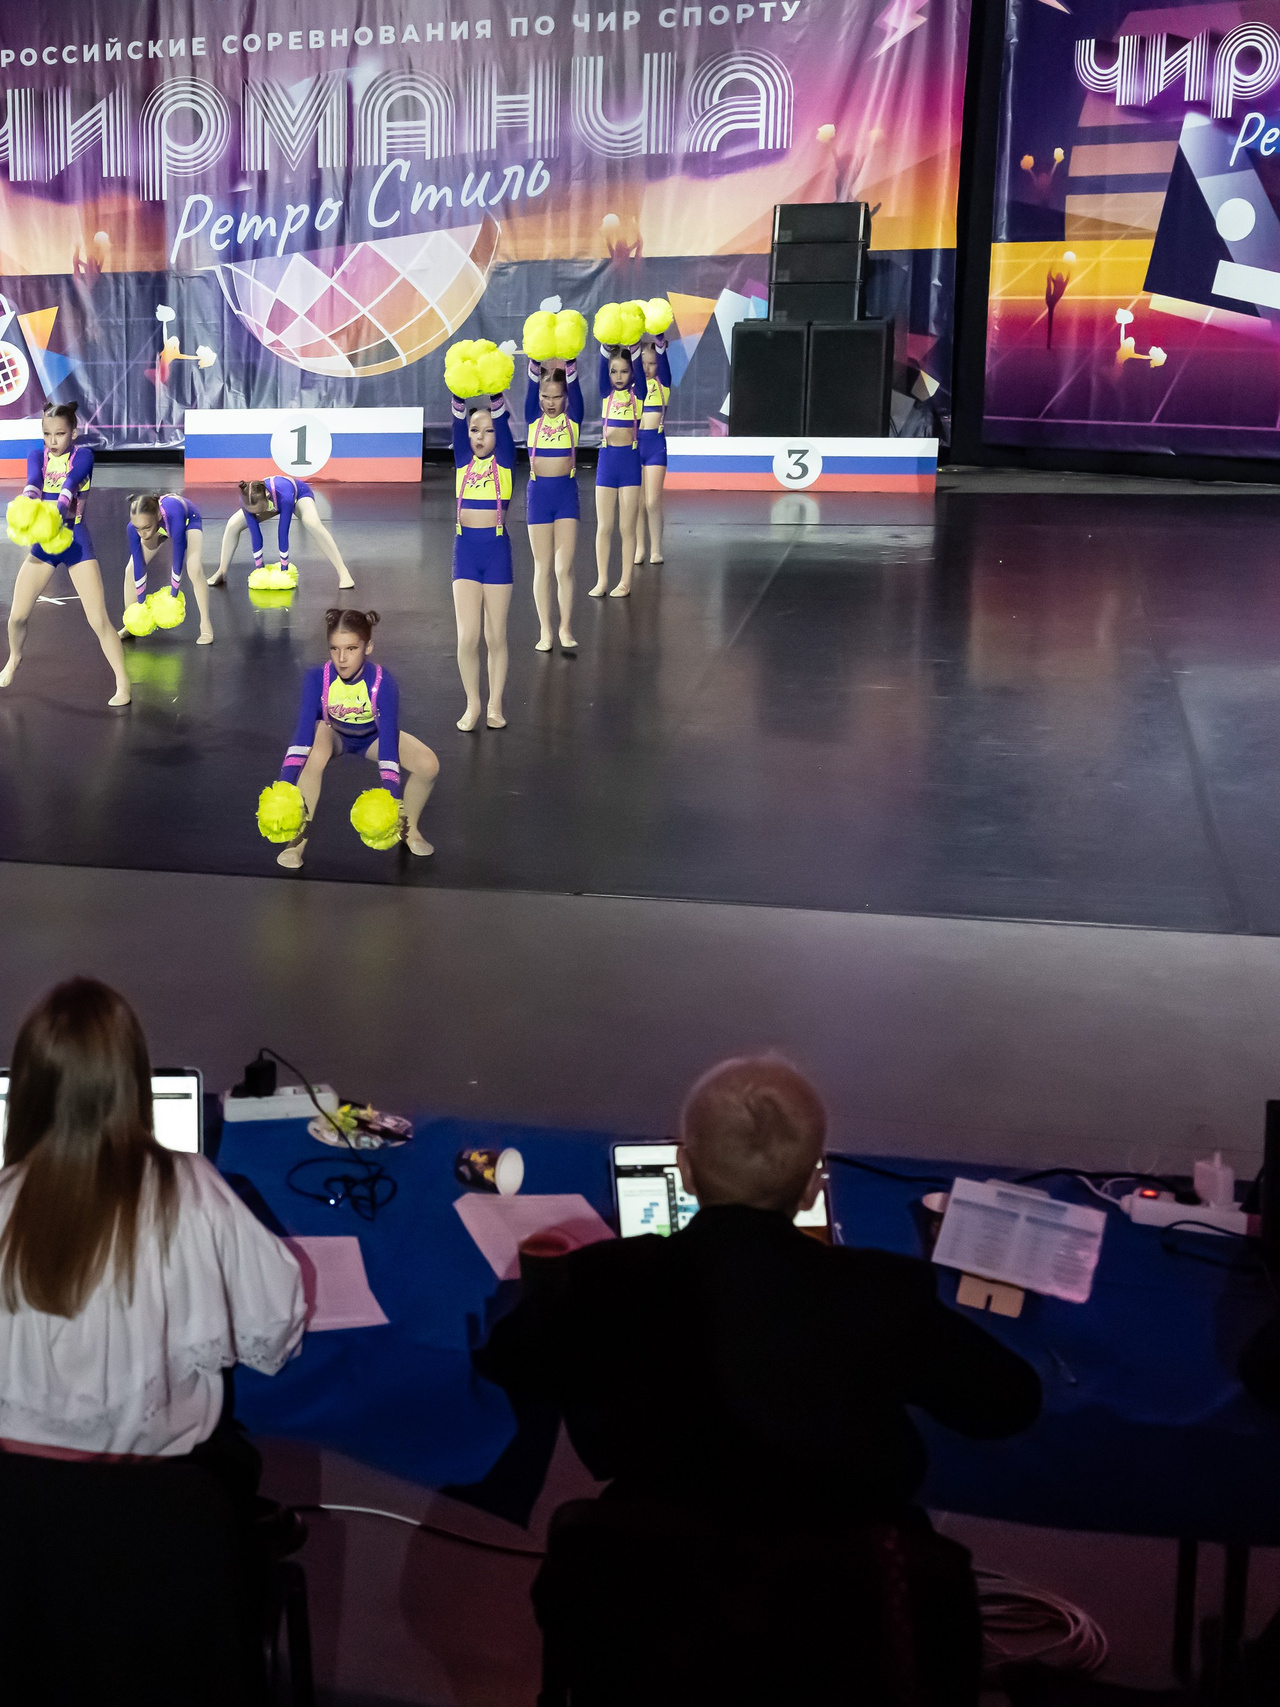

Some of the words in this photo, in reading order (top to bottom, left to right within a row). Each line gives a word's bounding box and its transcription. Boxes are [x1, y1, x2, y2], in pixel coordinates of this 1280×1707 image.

[221, 19, 492, 54] СОРЕВНОВАНИЯ
[510, 15, 555, 37] ПО
[572, 12, 641, 33] ЧИР
[658, 0, 801, 28] СПОРТУ
[170, 193, 344, 263] Ретро
[367, 158, 551, 228] Стиль
[290, 425, 312, 465] 1
[785, 449, 810, 480] 3
